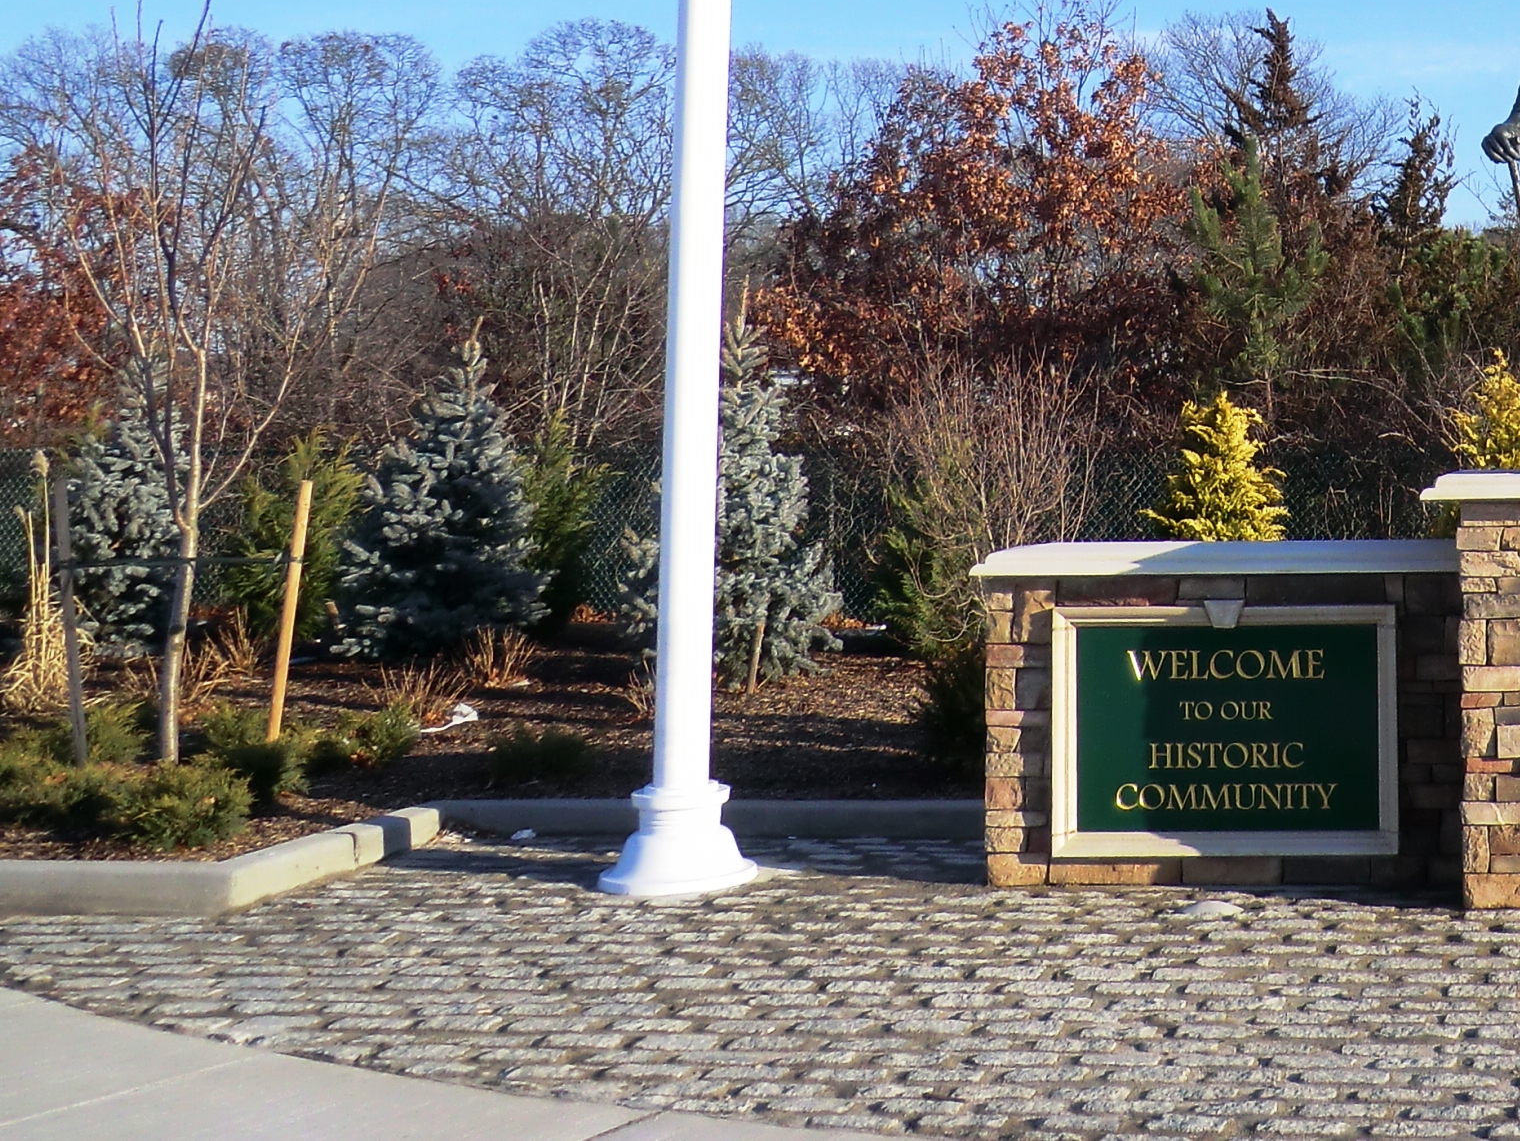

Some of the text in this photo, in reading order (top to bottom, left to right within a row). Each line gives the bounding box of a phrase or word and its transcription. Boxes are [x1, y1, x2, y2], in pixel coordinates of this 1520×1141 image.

[1127, 648, 1325, 680] WELCOME
[1180, 701, 1273, 721] TO OUR
[1148, 742, 1305, 771] HISTORIC
[1115, 783, 1338, 811] COMMUNITY
